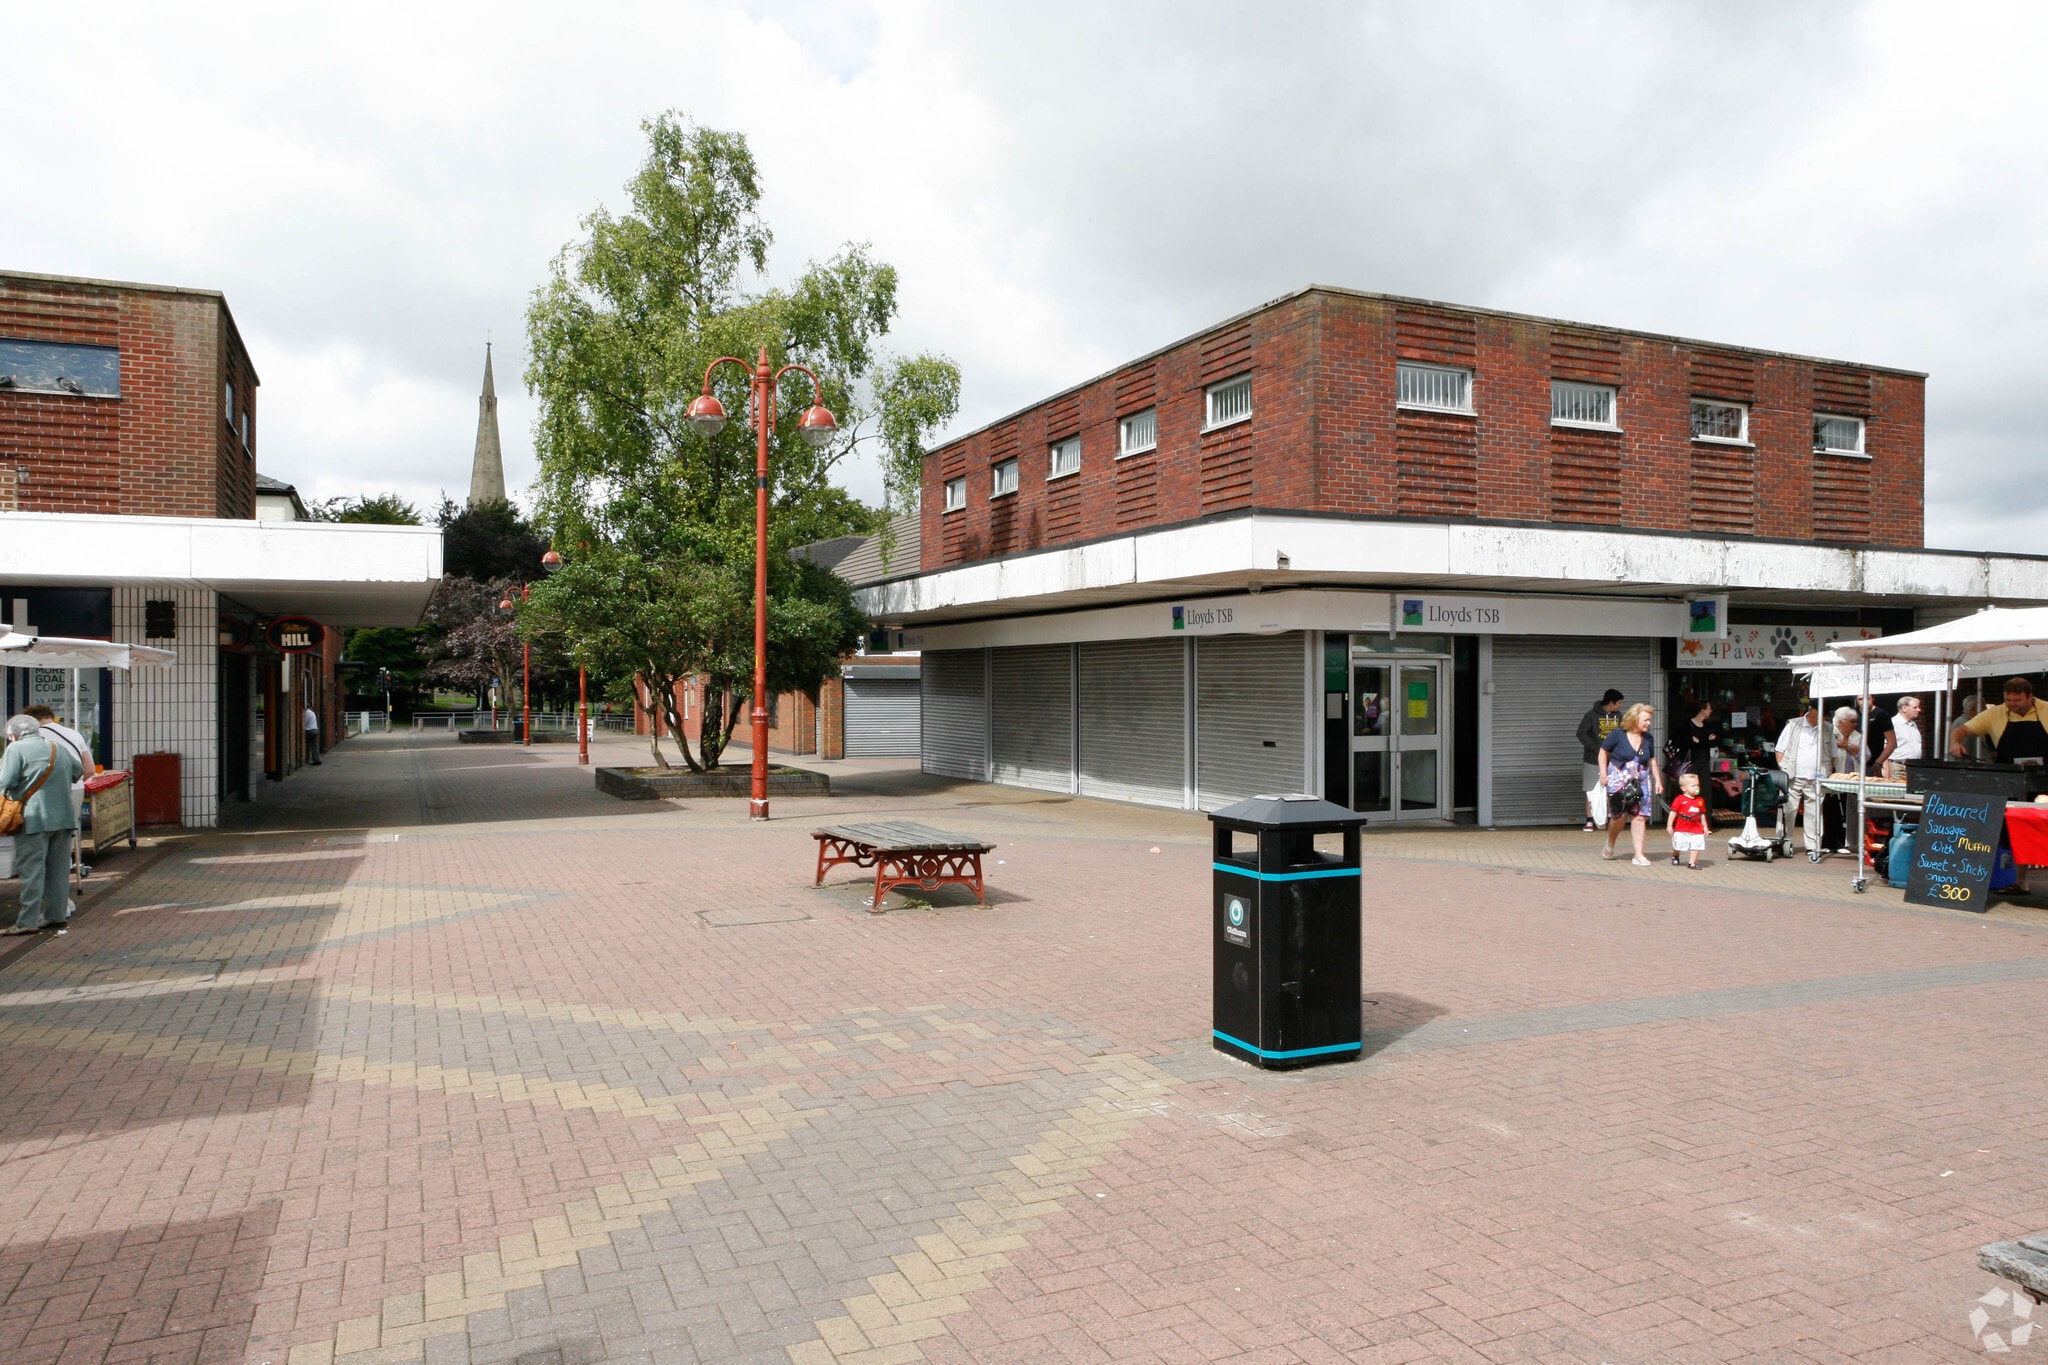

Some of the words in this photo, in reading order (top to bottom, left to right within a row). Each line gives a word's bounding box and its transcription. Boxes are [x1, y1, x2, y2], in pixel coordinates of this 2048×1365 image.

[1187, 608, 1214, 629] Lloyds
[1216, 608, 1233, 623] TSB
[1429, 605, 1472, 627] Lloyds
[1475, 608, 1500, 623] TSB
[281, 633, 312, 646] HILL
[1709, 642, 1719, 659] 4
[1721, 642, 1765, 660] Paws
[1841, 674, 1860, 686] Old
[1868, 672, 1893, 687] ridge
[1895, 671, 1925, 684] Bakery
[1925, 819, 1967, 842] Sausage
[1957, 837, 1991, 853] Muffin
[1917, 853, 1948, 872] Sweet
[1957, 858, 1989, 881] Sticky
